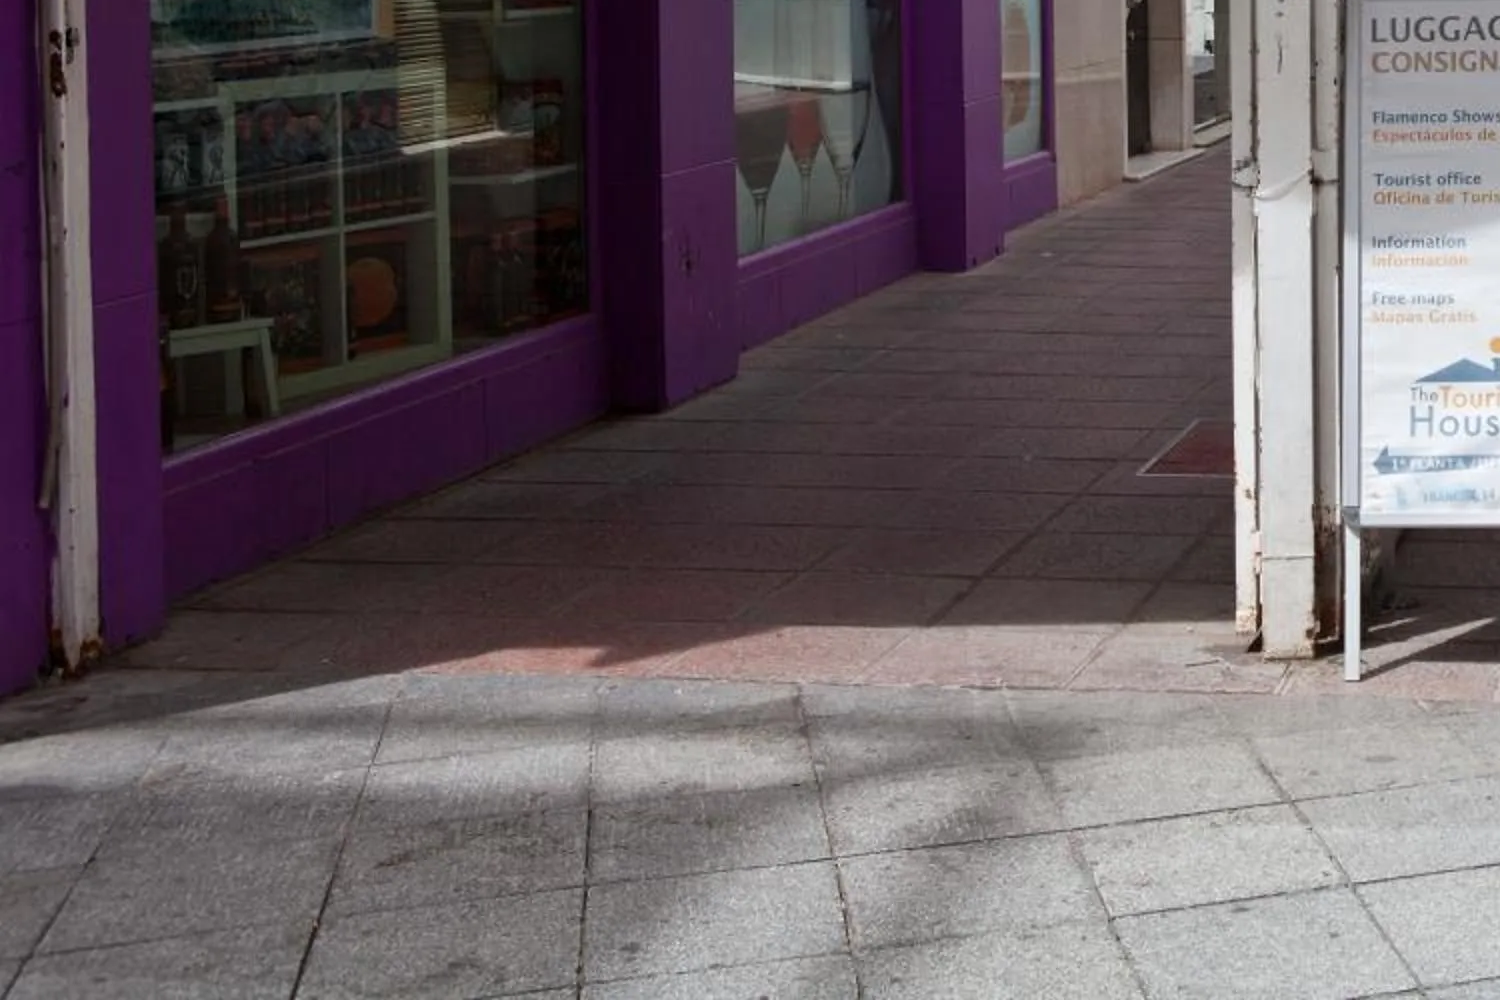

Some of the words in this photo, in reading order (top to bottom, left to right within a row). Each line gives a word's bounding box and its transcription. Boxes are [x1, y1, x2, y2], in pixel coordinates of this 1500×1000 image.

[1372, 111, 1448, 125] Flamenco
[1477, 128, 1497, 141] de
[1374, 172, 1431, 186] Tourist
[1437, 171, 1482, 185] office
[1374, 190, 1430, 205] Oficina
[1434, 190, 1454, 204] de
[1372, 235, 1467, 249] Information
[1372, 292, 1407, 305] Free
[1411, 293, 1455, 307] maps
[1370, 310, 1424, 325] Mapas
[1410, 386, 1438, 403] The
